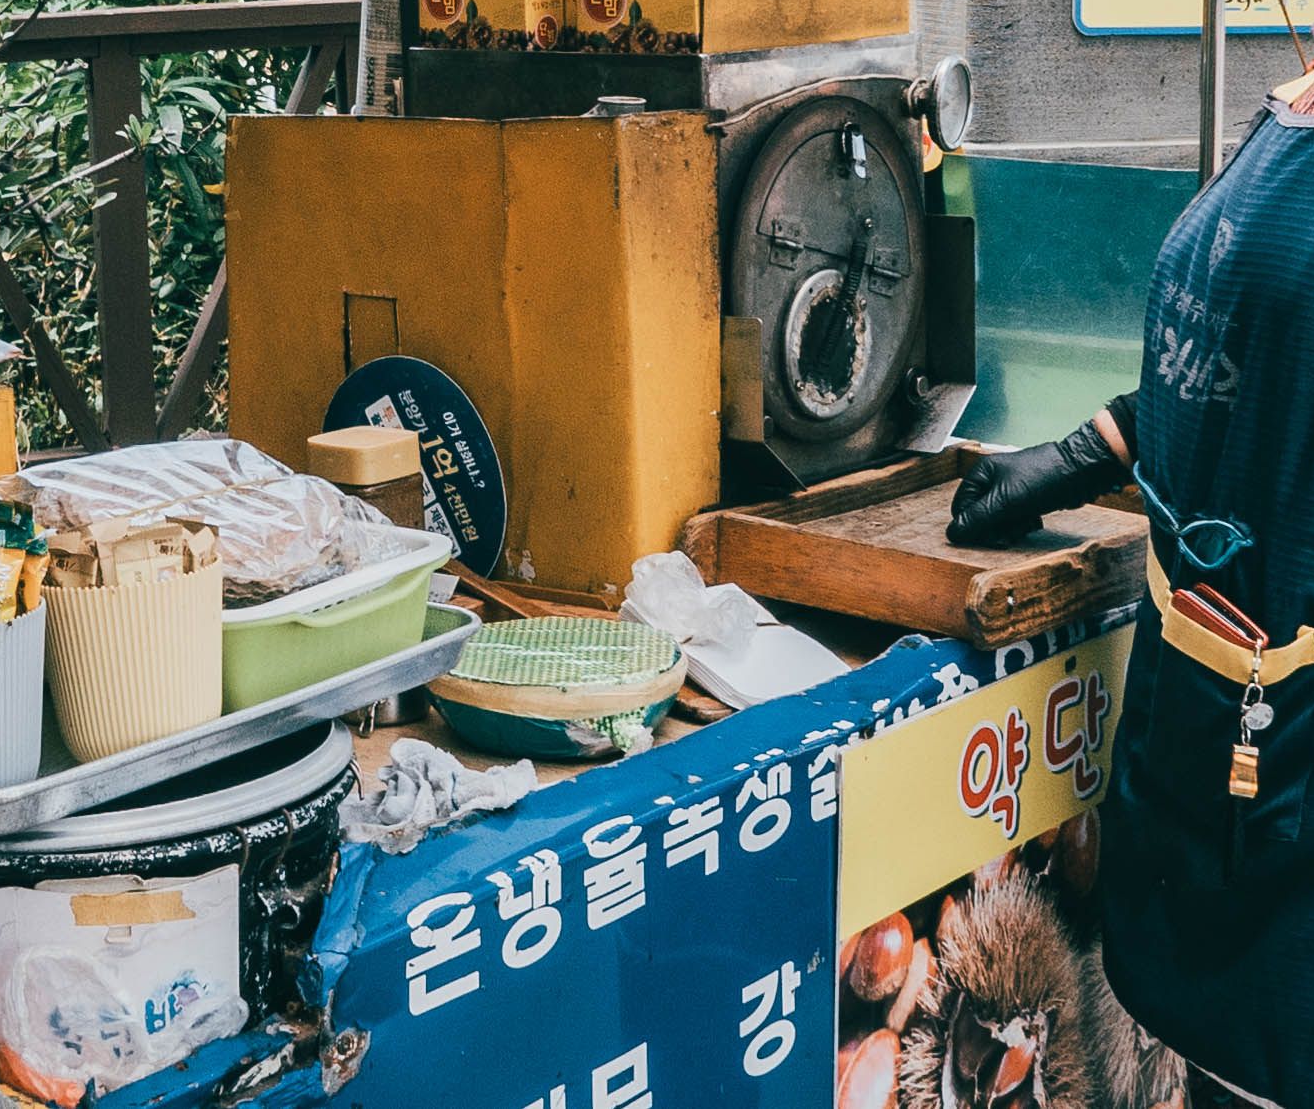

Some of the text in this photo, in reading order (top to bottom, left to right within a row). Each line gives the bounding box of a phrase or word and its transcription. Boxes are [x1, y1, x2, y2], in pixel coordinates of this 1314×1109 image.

[398, 389, 429, 434] 분양가
[421, 434, 460, 480] 1억
[443, 411, 462, 437] 이거
